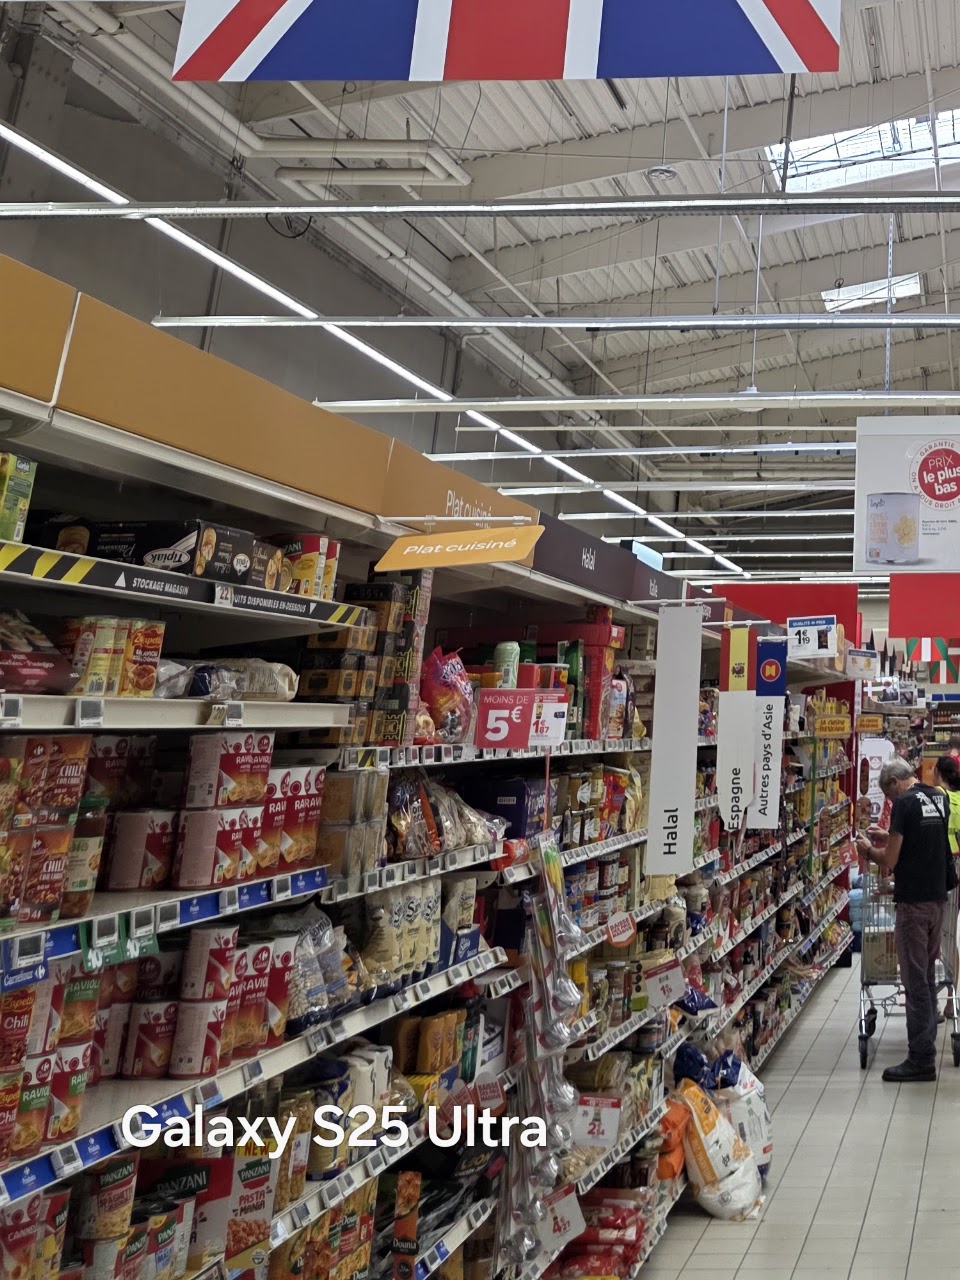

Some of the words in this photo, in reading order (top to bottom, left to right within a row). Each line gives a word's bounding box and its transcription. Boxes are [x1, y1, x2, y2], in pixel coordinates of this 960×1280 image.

[919, 441, 956, 457] GARANTIE
[928, 454, 954, 470] PRIX
[923, 470, 935, 484] le
[934, 481, 958, 496] bas
[446, 490, 463, 517] Plat
[935, 500, 956, 508] DROIT
[403, 544, 441, 556] Plat
[445, 538, 518, 553] cuisiné
[581, 547, 597, 571] Halal
[132, 577, 165, 591] STOCKAGE
[165, 582, 190, 595] MAGASIN
[247, 596, 279, 609] DISPONIBLES
[483, 694, 514, 704] MOINS
[516, 695, 529, 704] DE
[484, 705, 522, 741] 5€
[762, 703, 773, 747] d'Asie
[759, 749, 772, 774] pays
[728, 767, 741, 831] Espagne
[758, 776, 768, 816] Autres
[662, 807, 679, 856] Halal
[239, 1189, 266, 1206] PASTA
